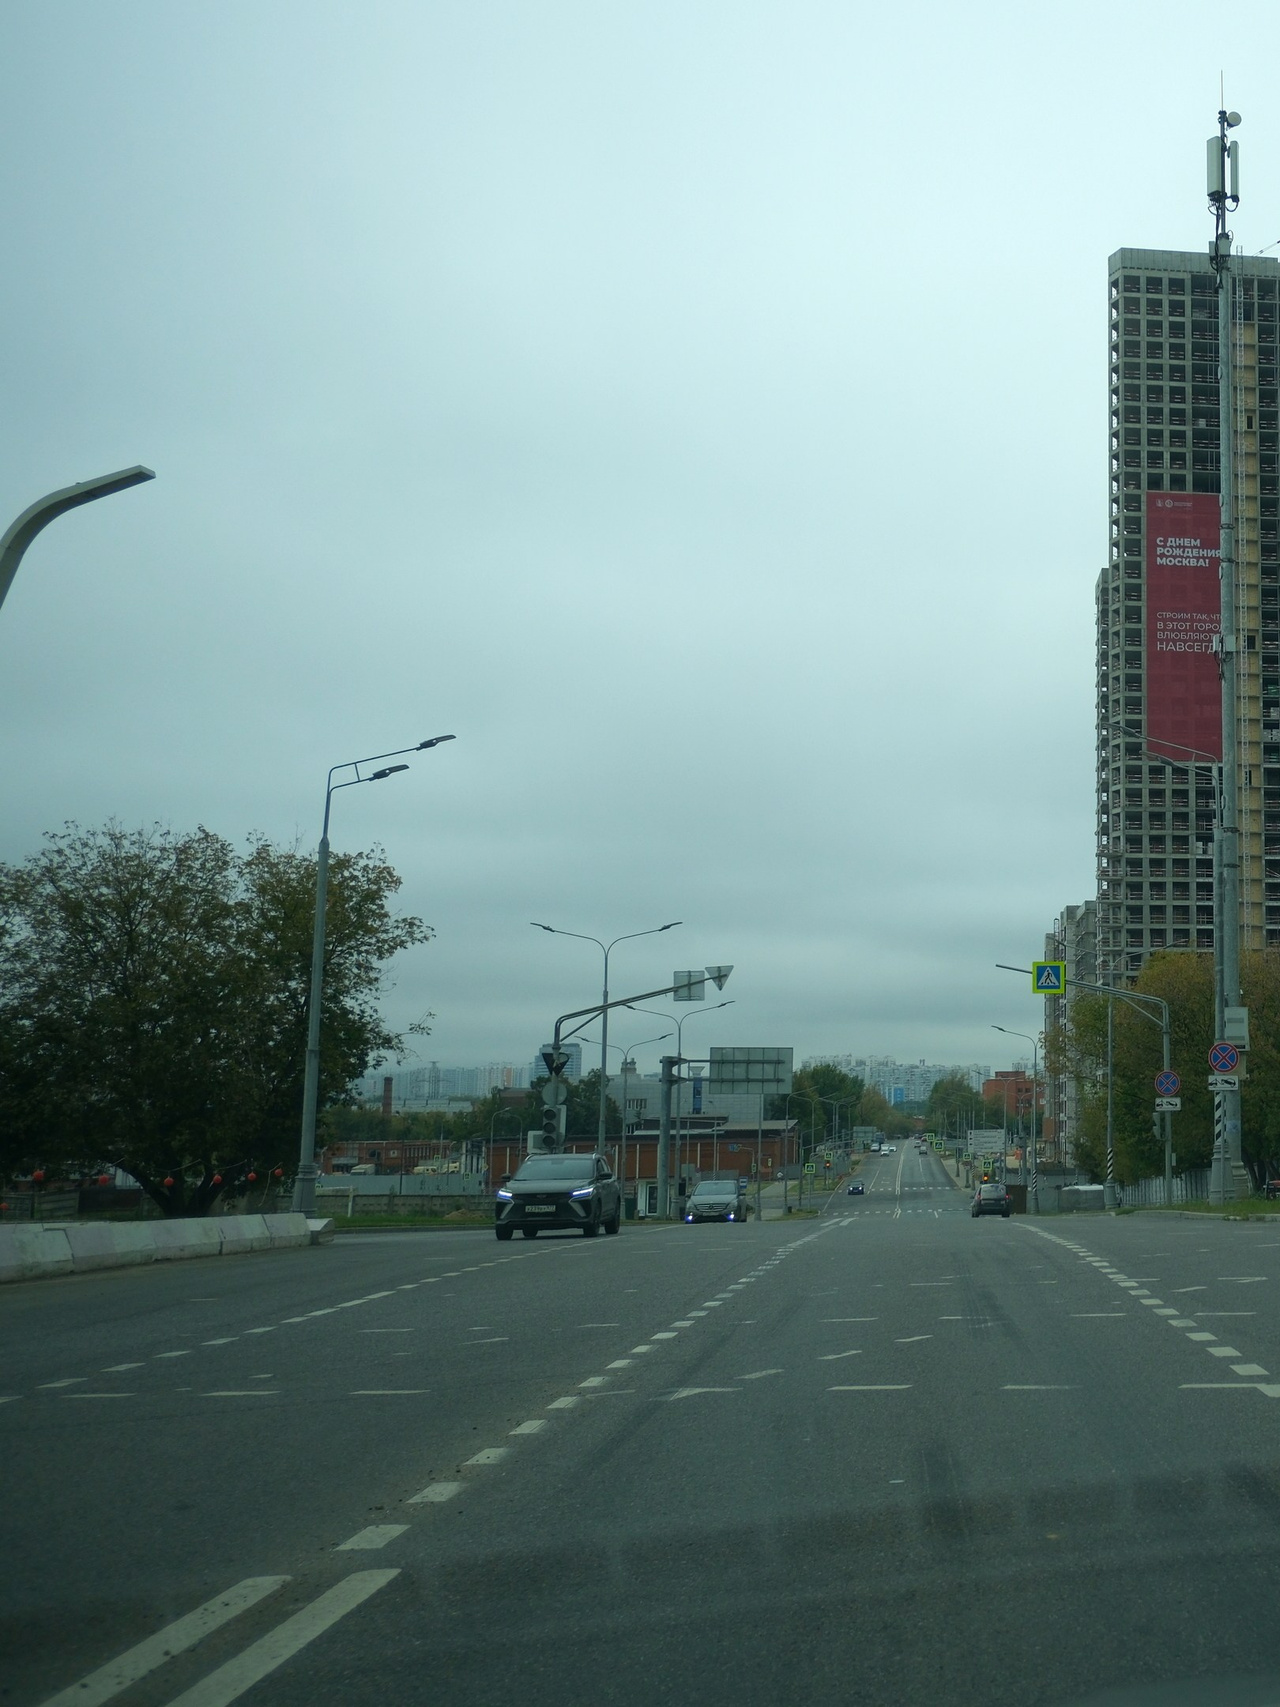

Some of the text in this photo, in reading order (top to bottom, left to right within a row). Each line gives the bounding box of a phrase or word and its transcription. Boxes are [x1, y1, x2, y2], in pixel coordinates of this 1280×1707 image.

[1156, 537, 1201, 547] С ДНЕМ
[1156, 557, 1209, 567] МОСКВА!
[1156, 612, 1191, 620] СТРОИМ
[1192, 613, 1210, 621] ТАК,
[1157, 621, 1222, 632] В ЭТОТ ГОРО
[1157, 631, 1215, 641] ВЛЮБЛЯЮТ
[1157, 642, 1215, 655] НАВСЕГД
